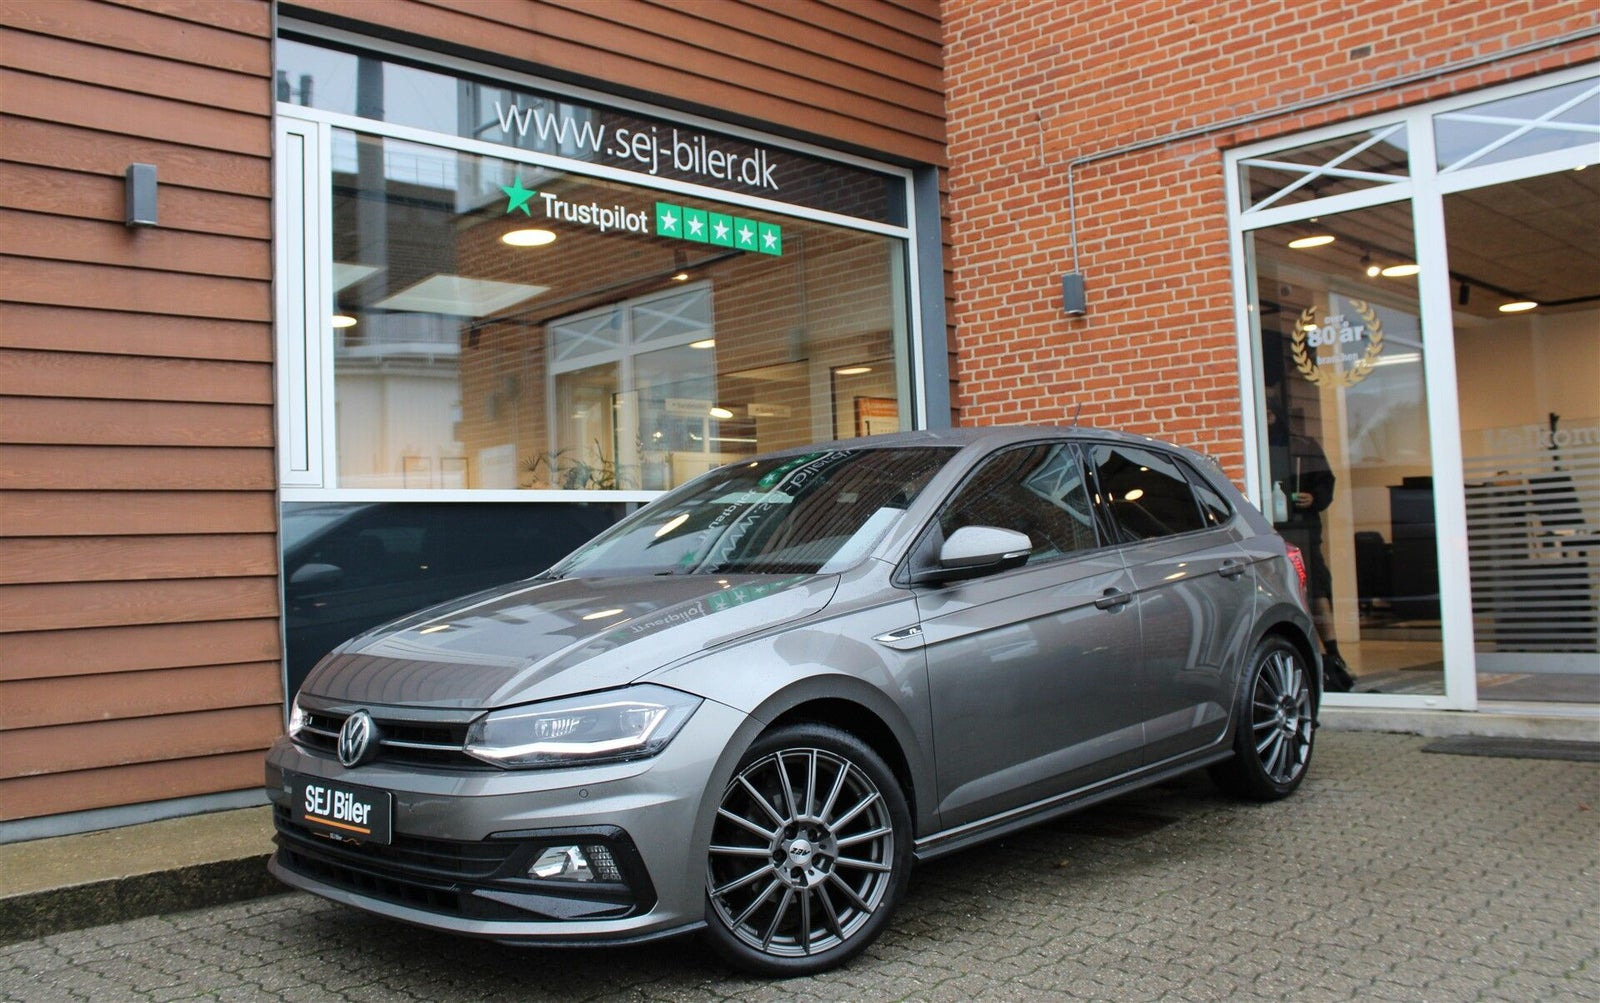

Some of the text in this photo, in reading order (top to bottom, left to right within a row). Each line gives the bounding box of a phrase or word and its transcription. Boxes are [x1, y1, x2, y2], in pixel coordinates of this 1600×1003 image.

[494, 100, 779, 191] www.sej-biler.dk
[540, 192, 649, 234] Trustpilot
[1307, 320, 1365, 347] 80 år
[304, 784, 371, 825] SEJ Biler
